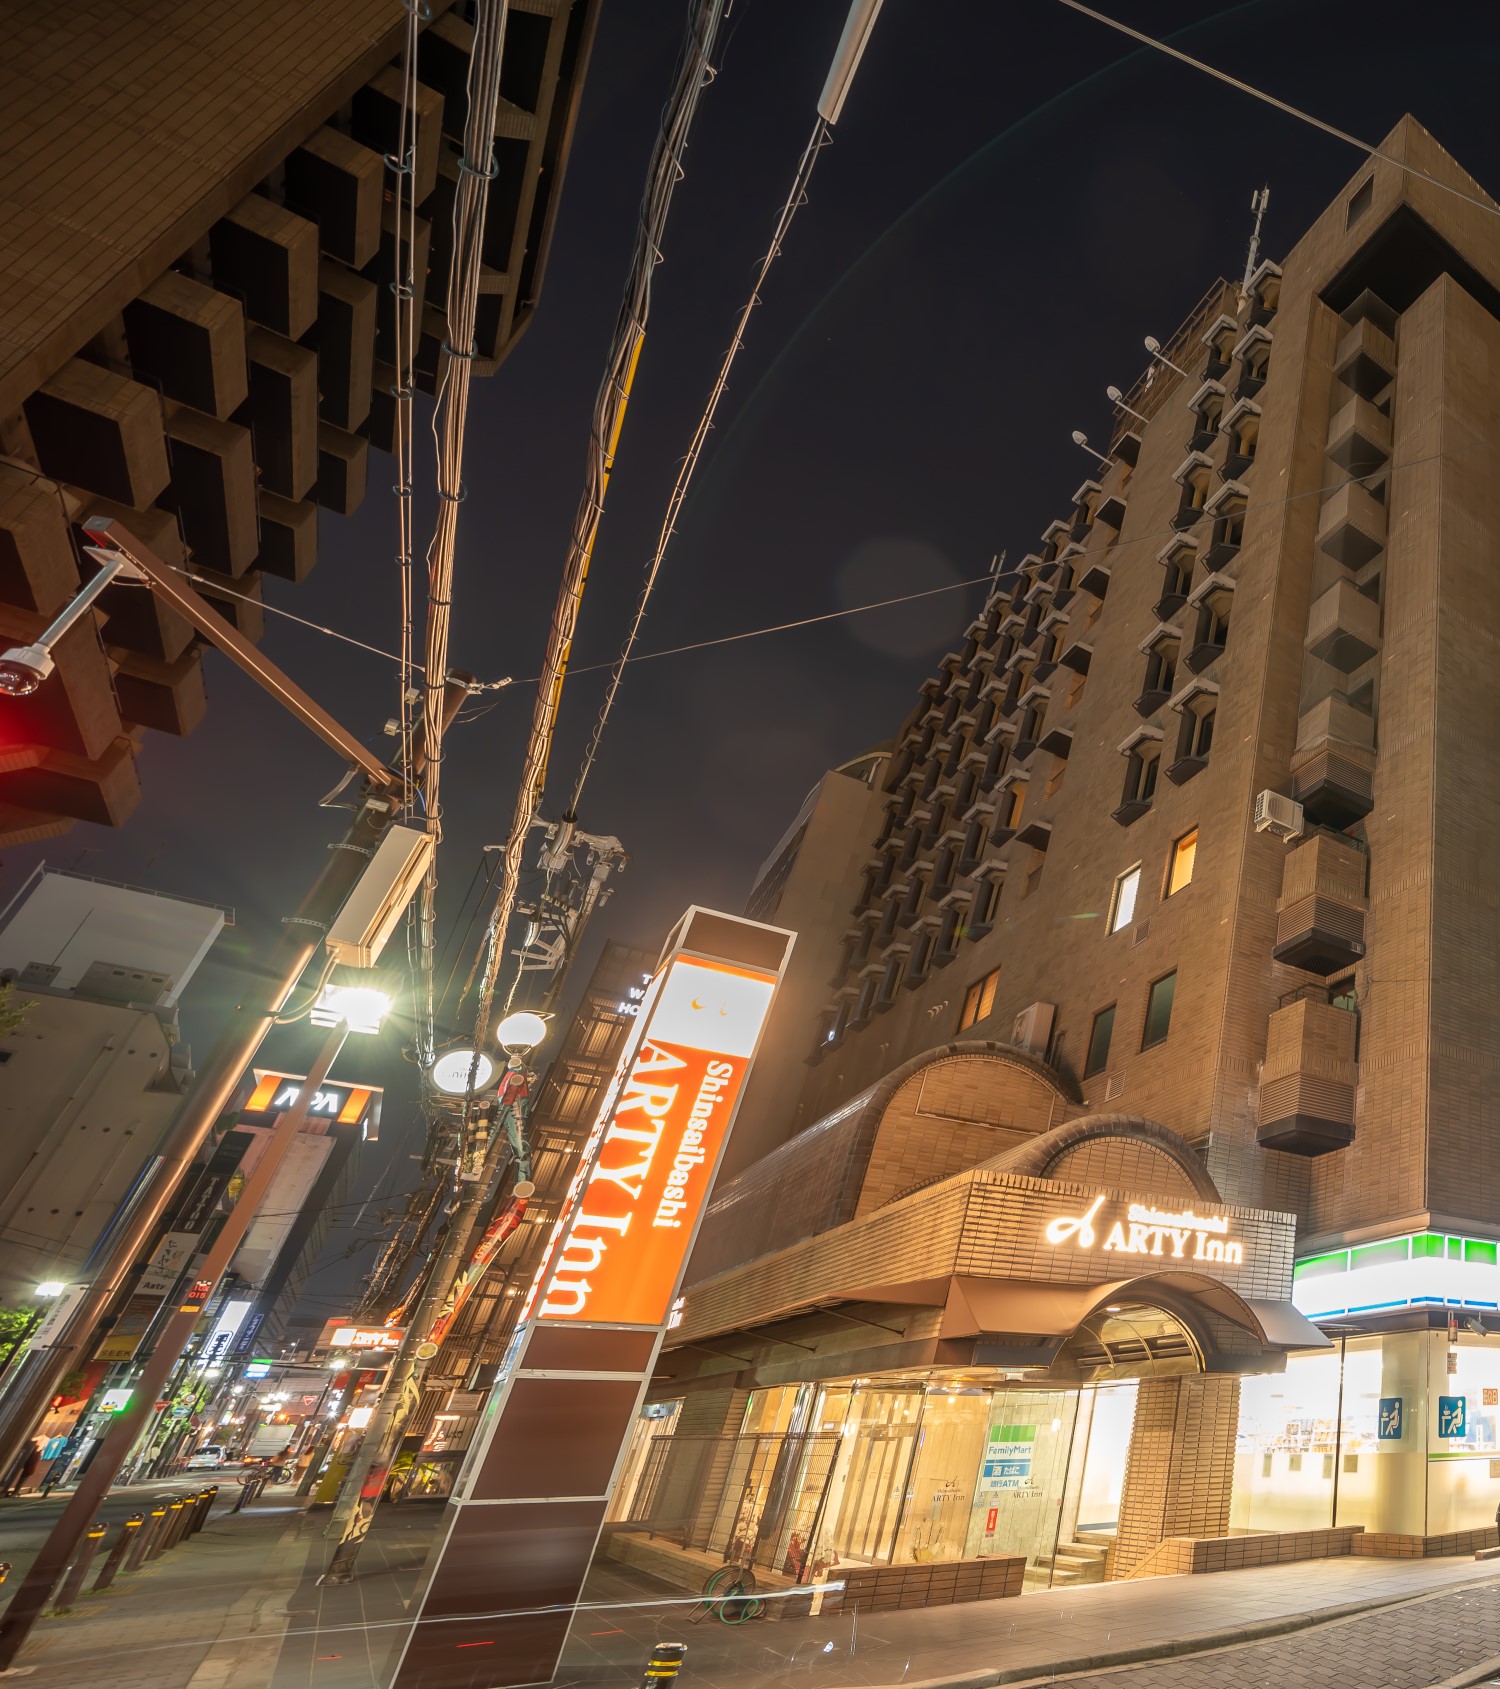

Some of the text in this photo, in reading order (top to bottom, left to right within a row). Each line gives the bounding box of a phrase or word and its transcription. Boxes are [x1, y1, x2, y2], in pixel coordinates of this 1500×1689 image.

[537, 1042, 688, 1318] ARTY Inn
[653, 1059, 733, 1228] Shinsaibashi
[1103, 1221, 1243, 1264] ARTY Inn
[988, 1446, 1031, 1456] FamilyMart
